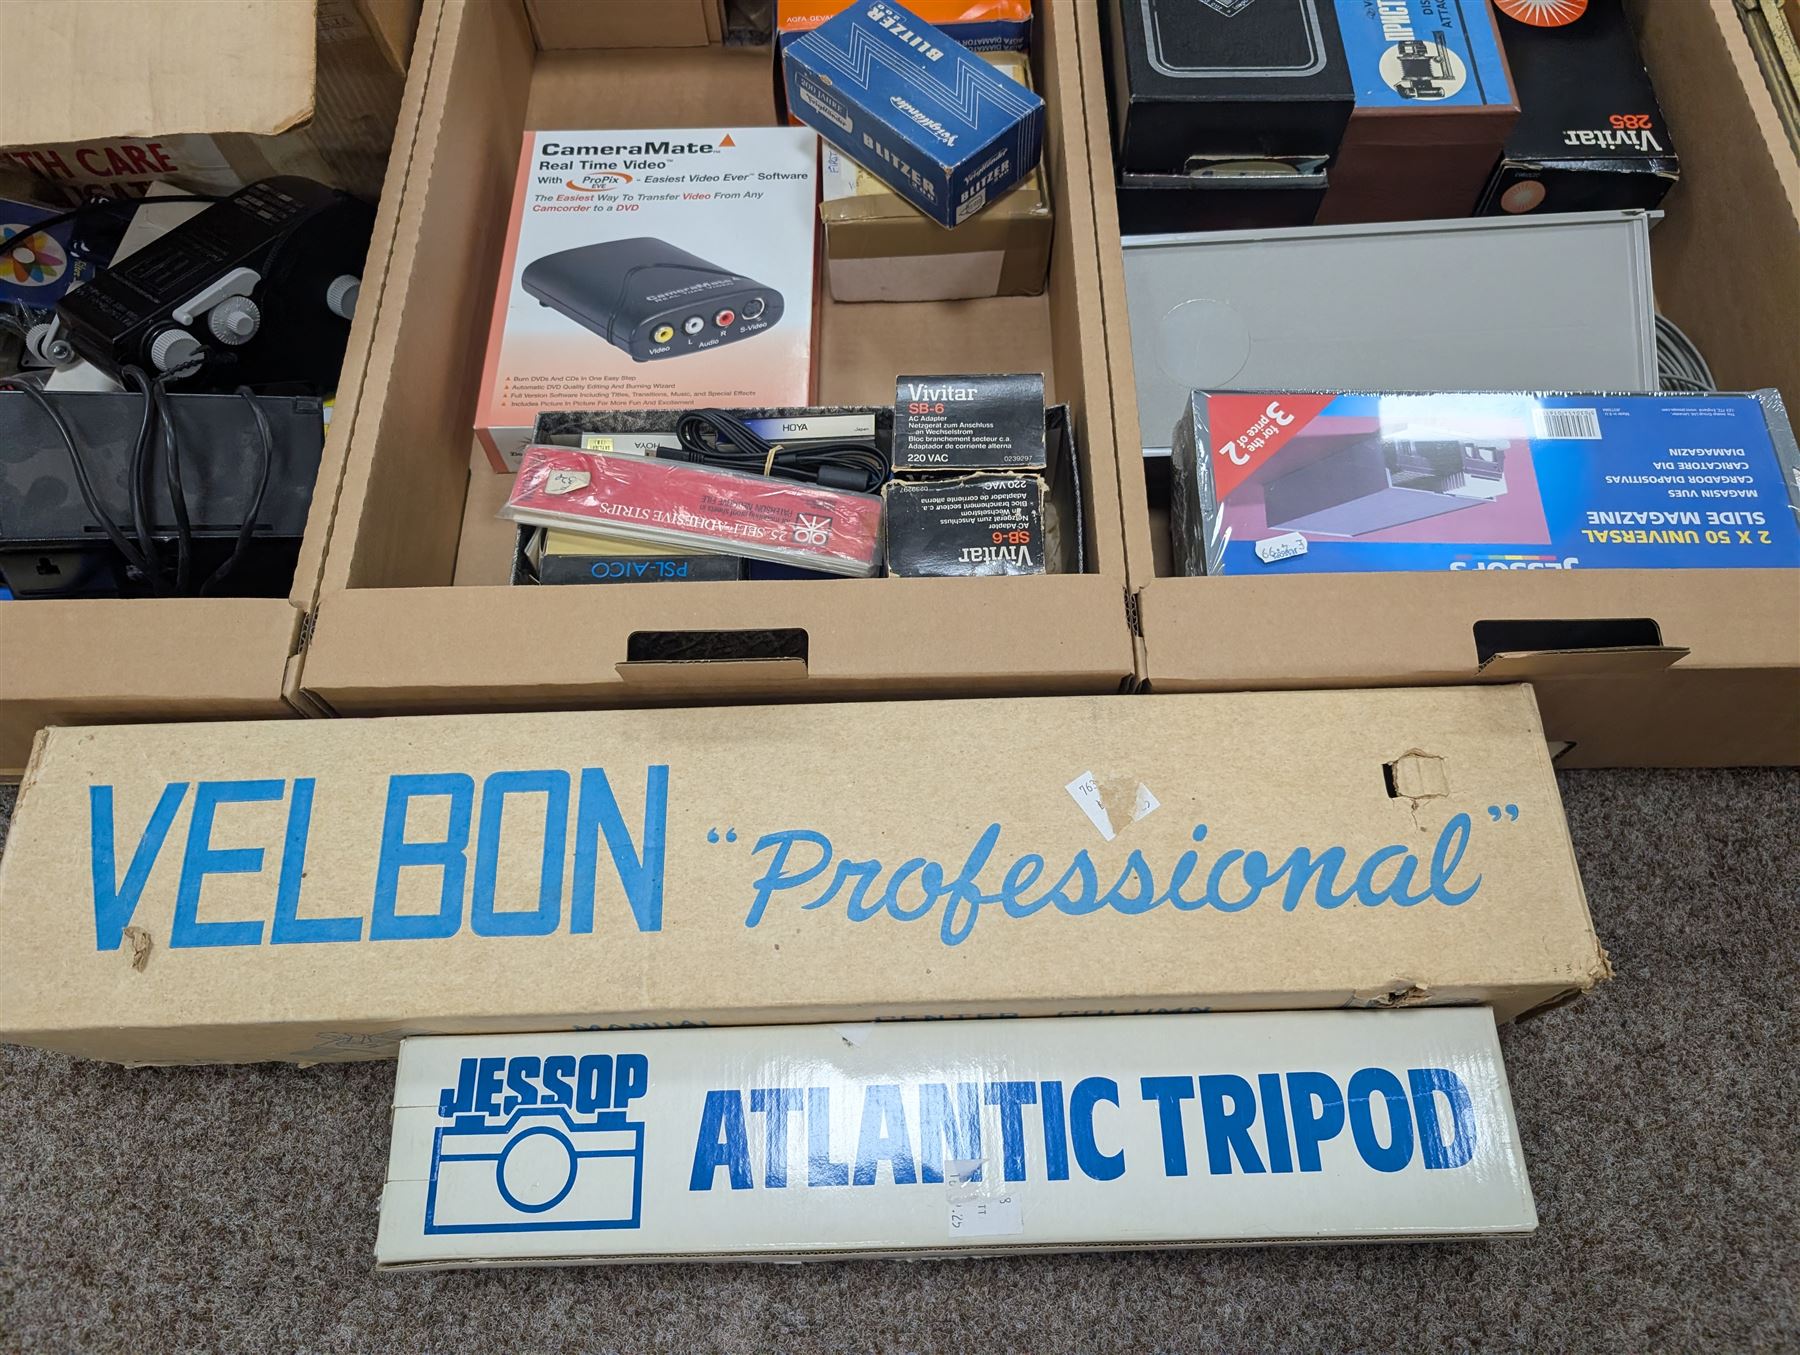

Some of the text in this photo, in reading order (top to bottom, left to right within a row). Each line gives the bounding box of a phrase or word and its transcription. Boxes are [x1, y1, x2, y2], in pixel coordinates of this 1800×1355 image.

[867, 7, 944, 61] BLITZER
[1609, 114, 1653, 129] 285
[1564, 130, 1663, 151] Vivitar
[76, 143, 179, 177] CARE
[539, 161, 573, 171] Real
[579, 161, 617, 170] Time
[863, 132, 935, 196] BLITZER
[537, 176, 563, 185] With
[582, 176, 619, 184] ProPix
[644, 175, 686, 183] Easiest
[689, 174, 720, 183] Video
[758, 172, 808, 181] Software
[961, 160, 1009, 203] BLITZER
[535, 194, 553, 202] The
[556, 194, 594, 202] Easiest
[597, 194, 619, 203] Way
[637, 192, 680, 201] Transfer
[683, 192, 711, 200] Video
[743, 191, 764, 199] Any
[532, 204, 591, 213] Camcorder
[740, 321, 768, 333] S-Video
[649, 346, 671, 356] Video
[699, 339, 719, 349] Audio
[908, 384, 977, 401] Vivitar
[908, 403, 945, 414] SB-6
[1265, 401, 1295, 426] 3
[1236, 415, 1270, 449] price of
[1246, 425, 1280, 452] for the
[907, 453, 949, 462] 220 VAC
[1219, 441, 1250, 466] 2
[1669, 448, 1745, 456] DIAMAGAZIN
[1653, 462, 1749, 470] CARICATORE DIA
[984, 480, 1027, 490] 220 VAC
[1605, 476, 1754, 484] CARGADOR DIAPOSITIVAS
[1668, 489, 1758, 498] MAGASIN VUES
[599, 502, 650, 520] STRIPS
[960, 508, 1011, 516] Wechselstrom
[963, 501, 1010, 509] branchement
[1586, 511, 1767, 525] SLIDE MAGAZINE
[771, 528, 788, 542] 25
[992, 531, 1030, 544] SB-6
[1581, 530, 1772, 544] 2 X 50 UNIVERSAL
[958, 546, 1033, 566] Vivitar
[591, 561, 688, 578] PSL-AICO
[89, 764, 670, 952] VELBON
[437, 1053, 649, 1119] JESSOP
[688, 1067, 1478, 1192] ATLANTIC TRIPOD
